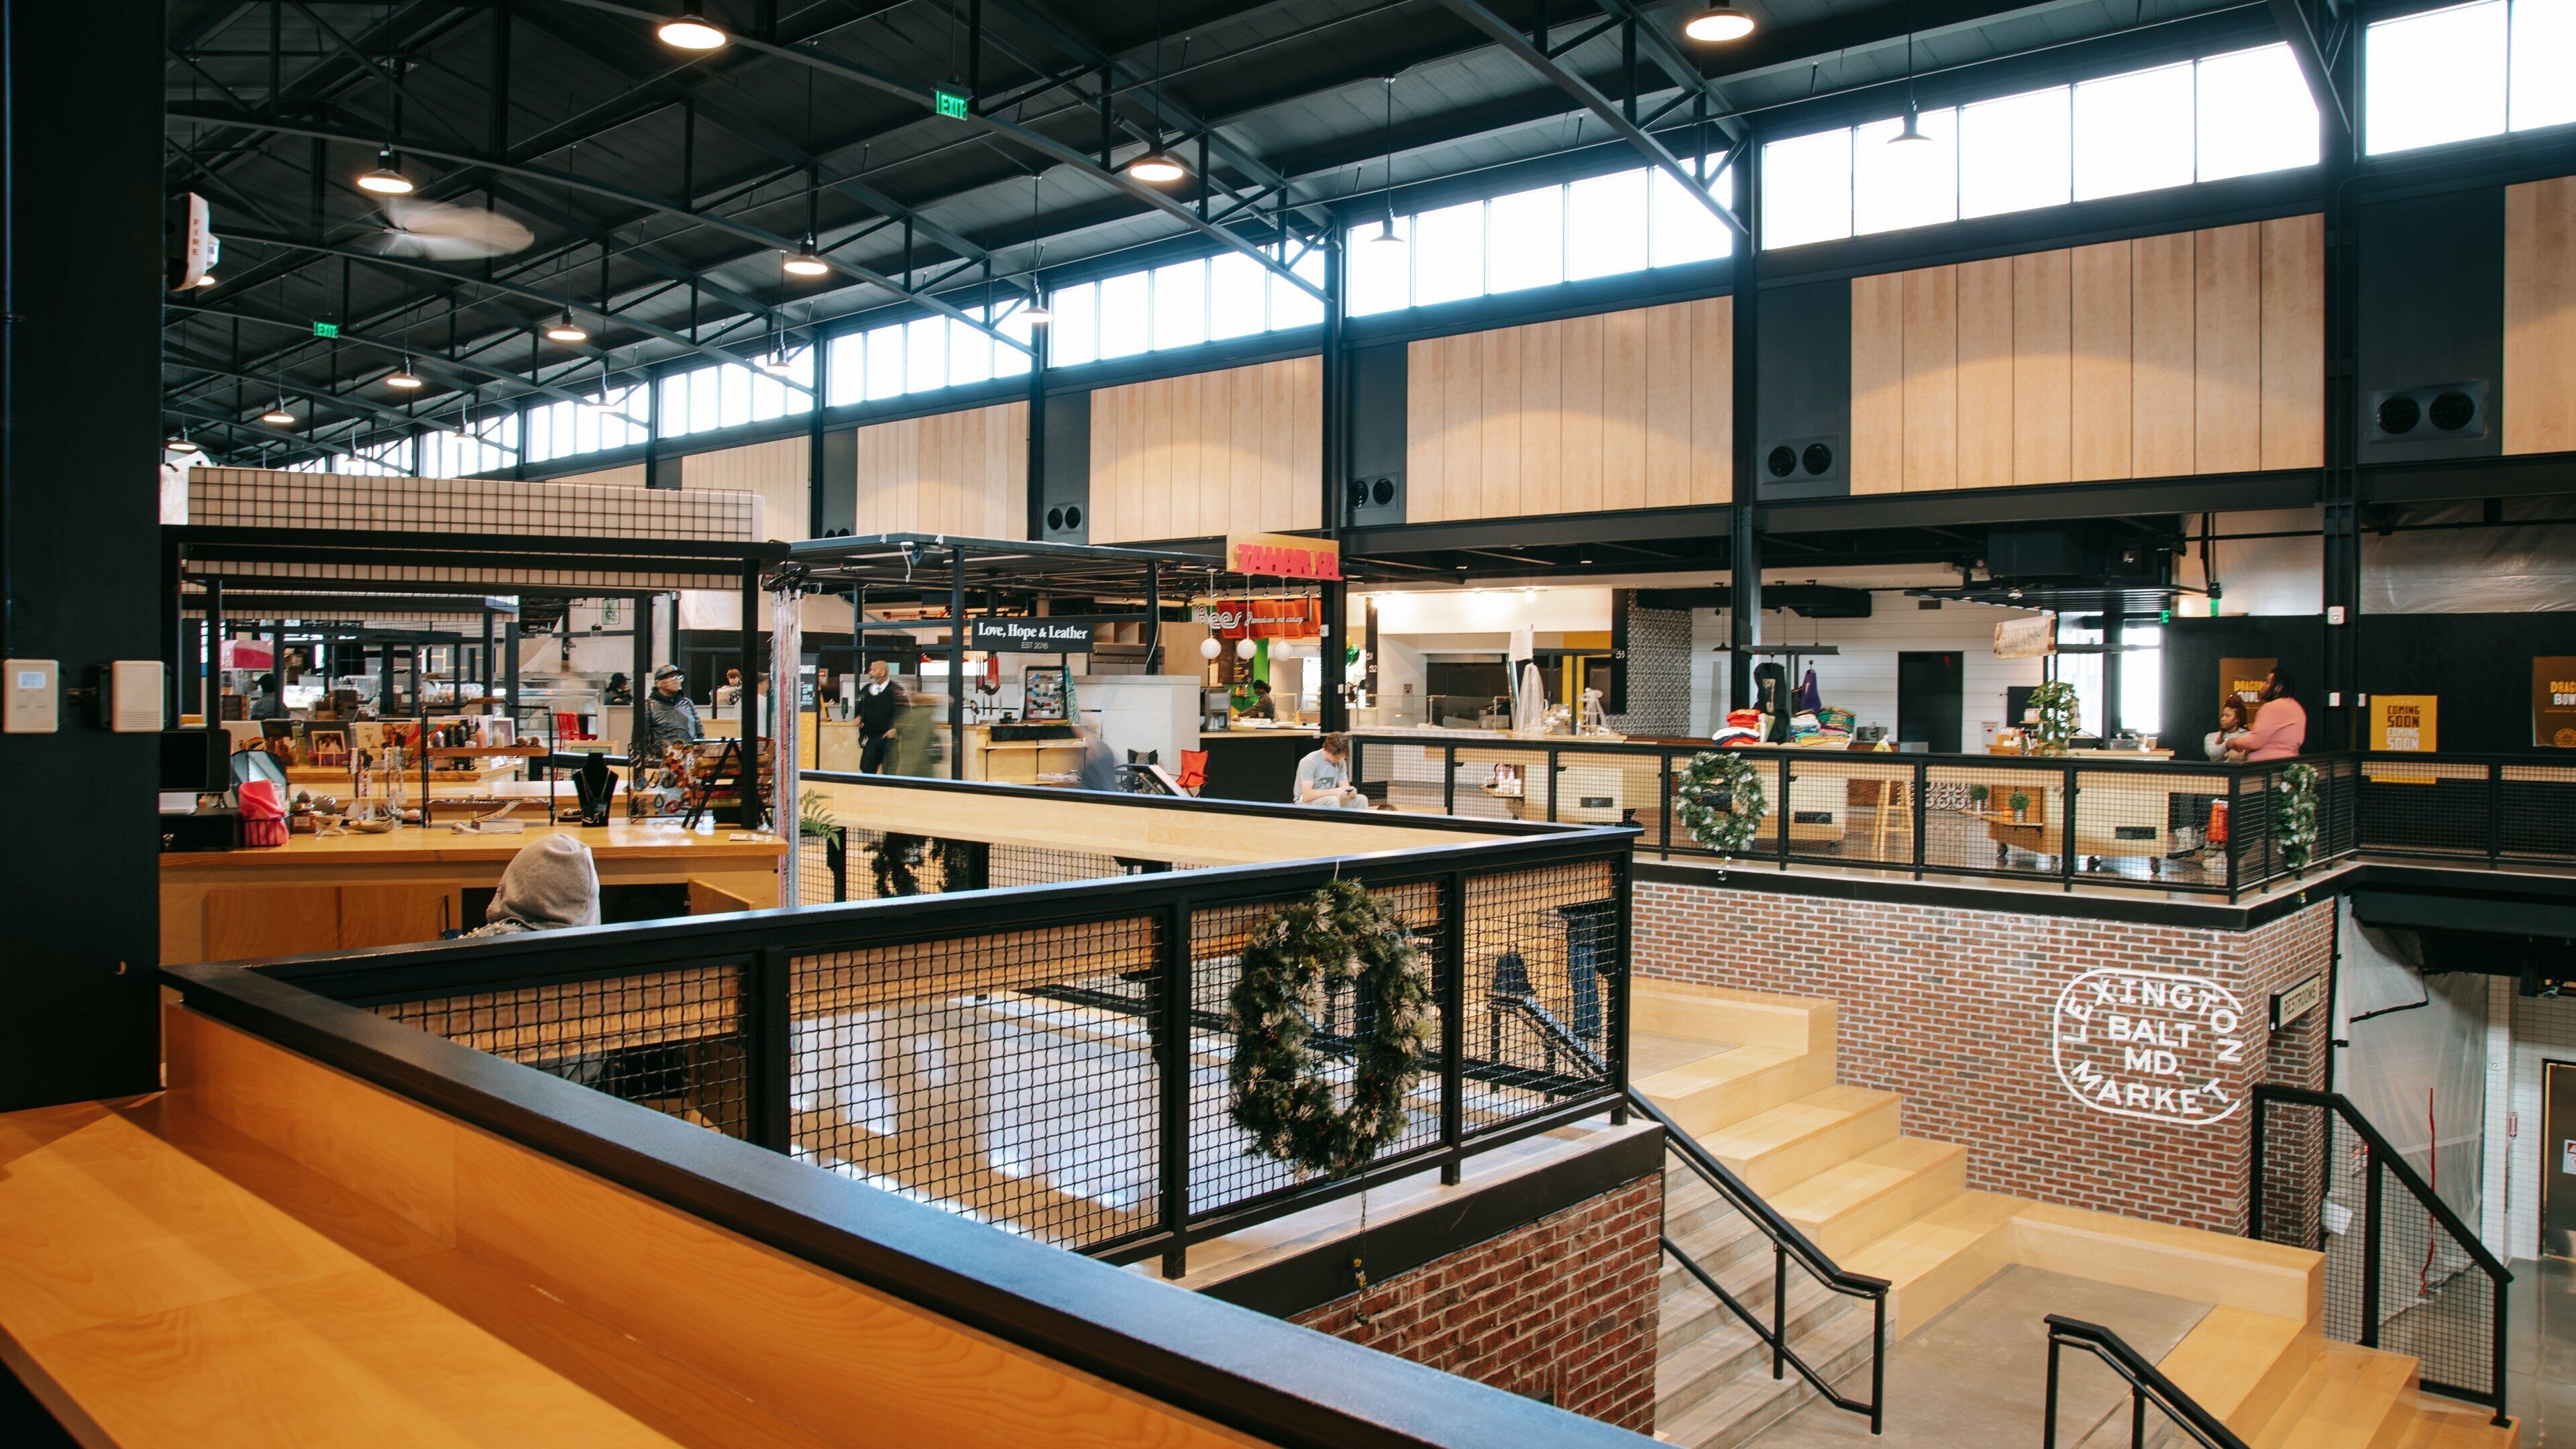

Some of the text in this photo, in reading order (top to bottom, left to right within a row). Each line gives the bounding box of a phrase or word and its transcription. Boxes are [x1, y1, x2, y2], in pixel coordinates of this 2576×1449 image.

[941, 95, 965, 118] EXIT
[317, 323, 337, 337] EXIT
[1234, 543, 1339, 579] TAHARKA
[978, 623, 1088, 641] Love, Hope & Leather
[1368, 665, 1378, 673] 52
[2550, 681, 2576, 693] DRAG
[2553, 693, 2576, 706] BOW
[2387, 706, 2420, 715] COMING
[2387, 715, 2420, 729] SOON
[2385, 728, 2420, 738] COMING
[2386, 737, 2420, 751] SOON
[2284, 982, 2316, 1016] RESTROOMS
[2062, 979, 2243, 1062] LEXINGTON
[2108, 1015, 2196, 1048] BALT
[2125, 1046, 2183, 1077] MD.
[2070, 1059, 2229, 1114] MARKET
